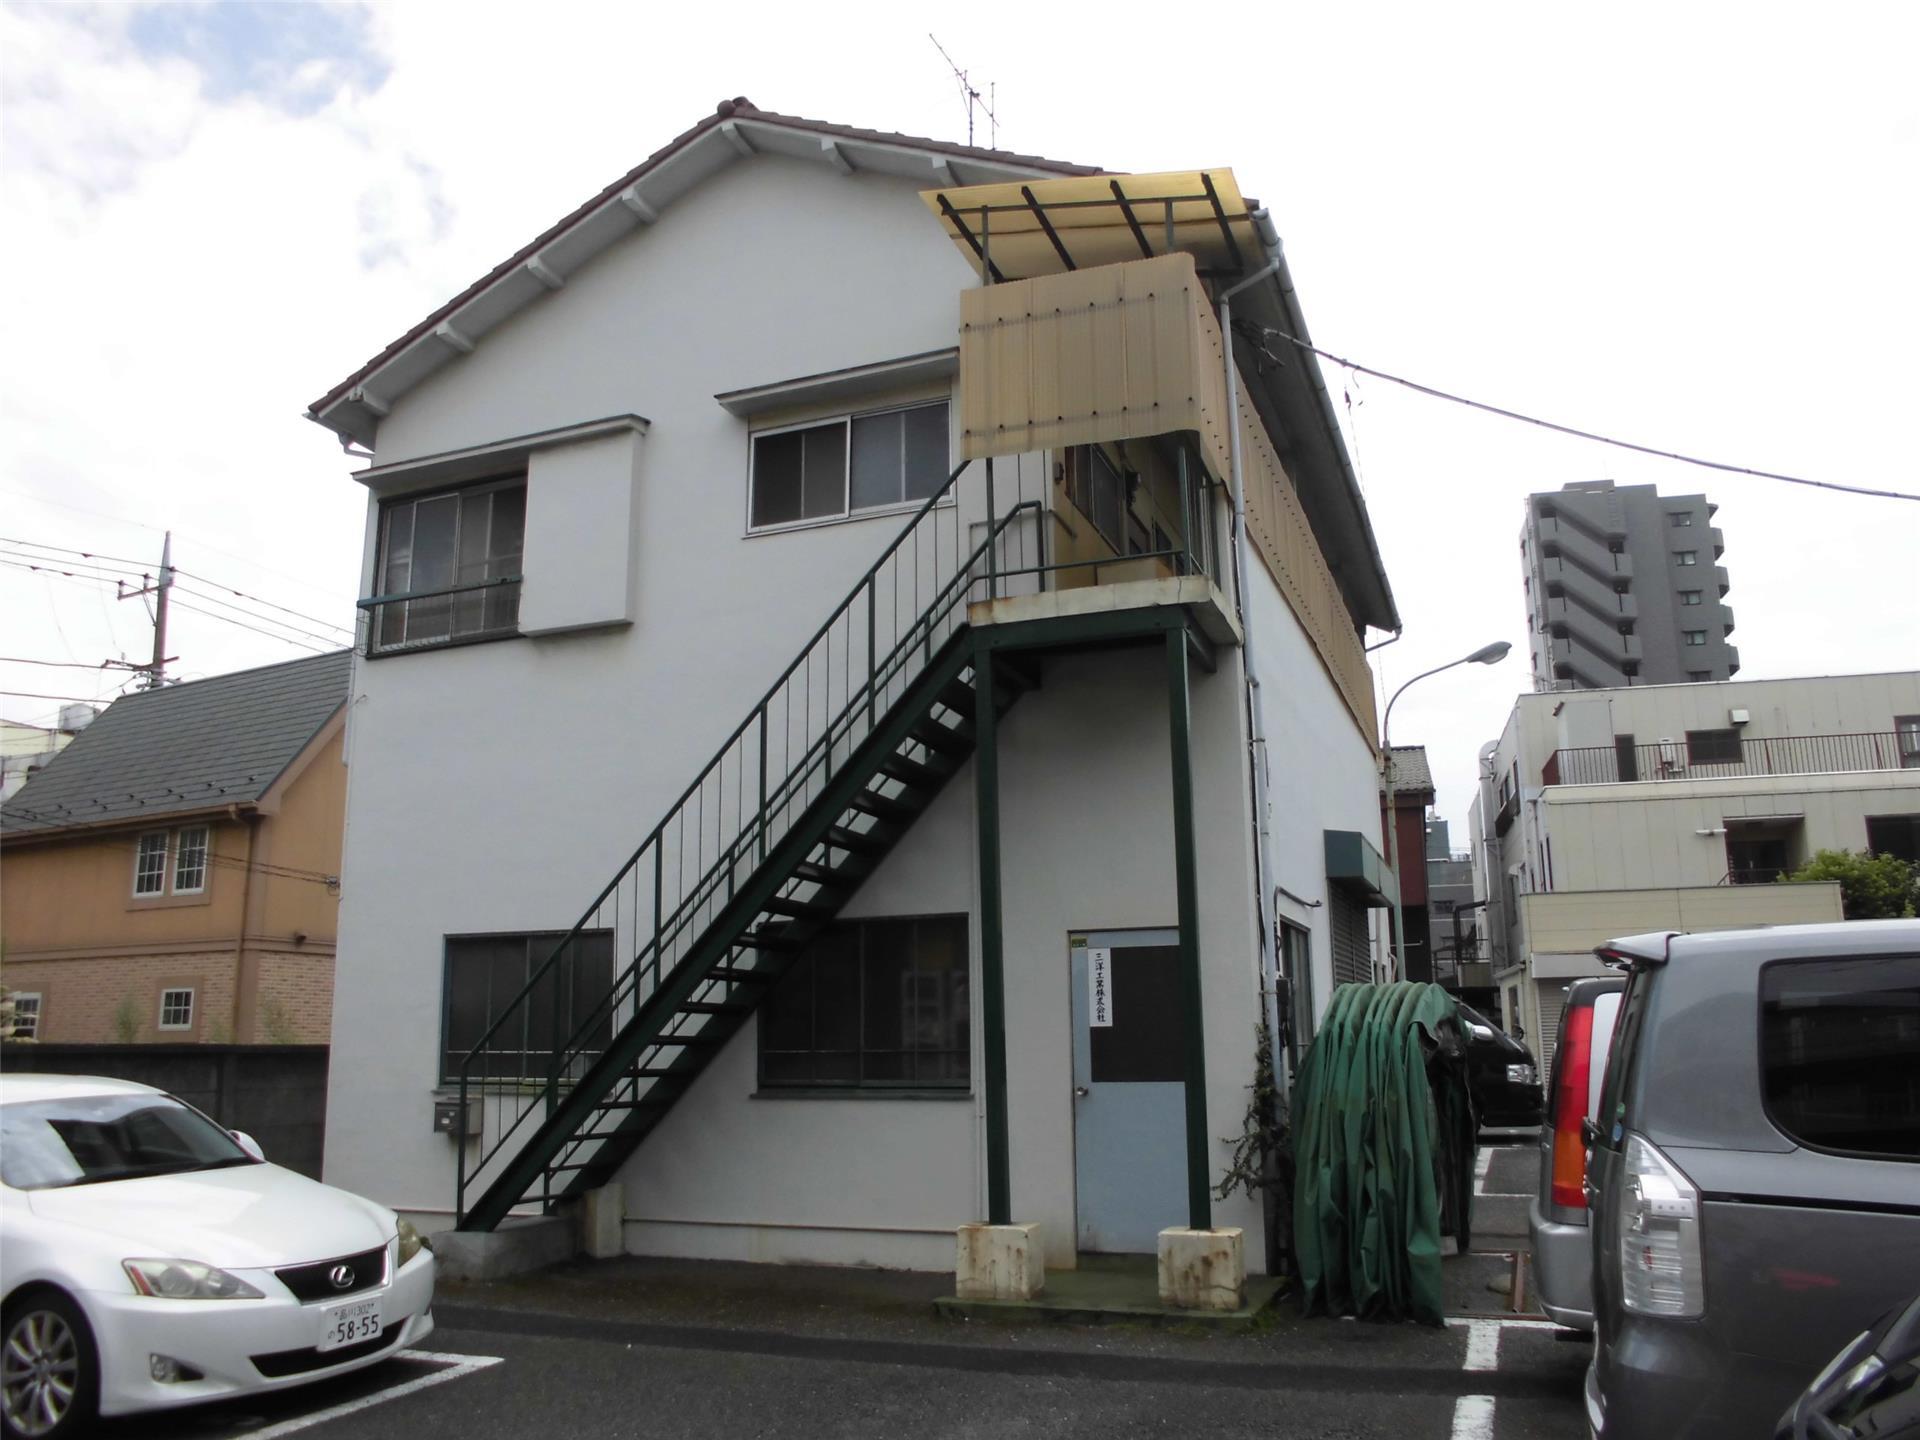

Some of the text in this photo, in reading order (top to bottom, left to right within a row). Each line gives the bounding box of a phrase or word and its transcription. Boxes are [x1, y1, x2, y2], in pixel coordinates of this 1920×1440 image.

[1095, 952, 1106, 1023] 三洋工業株式会社
[337, 1313, 379, 1343] 58-55
